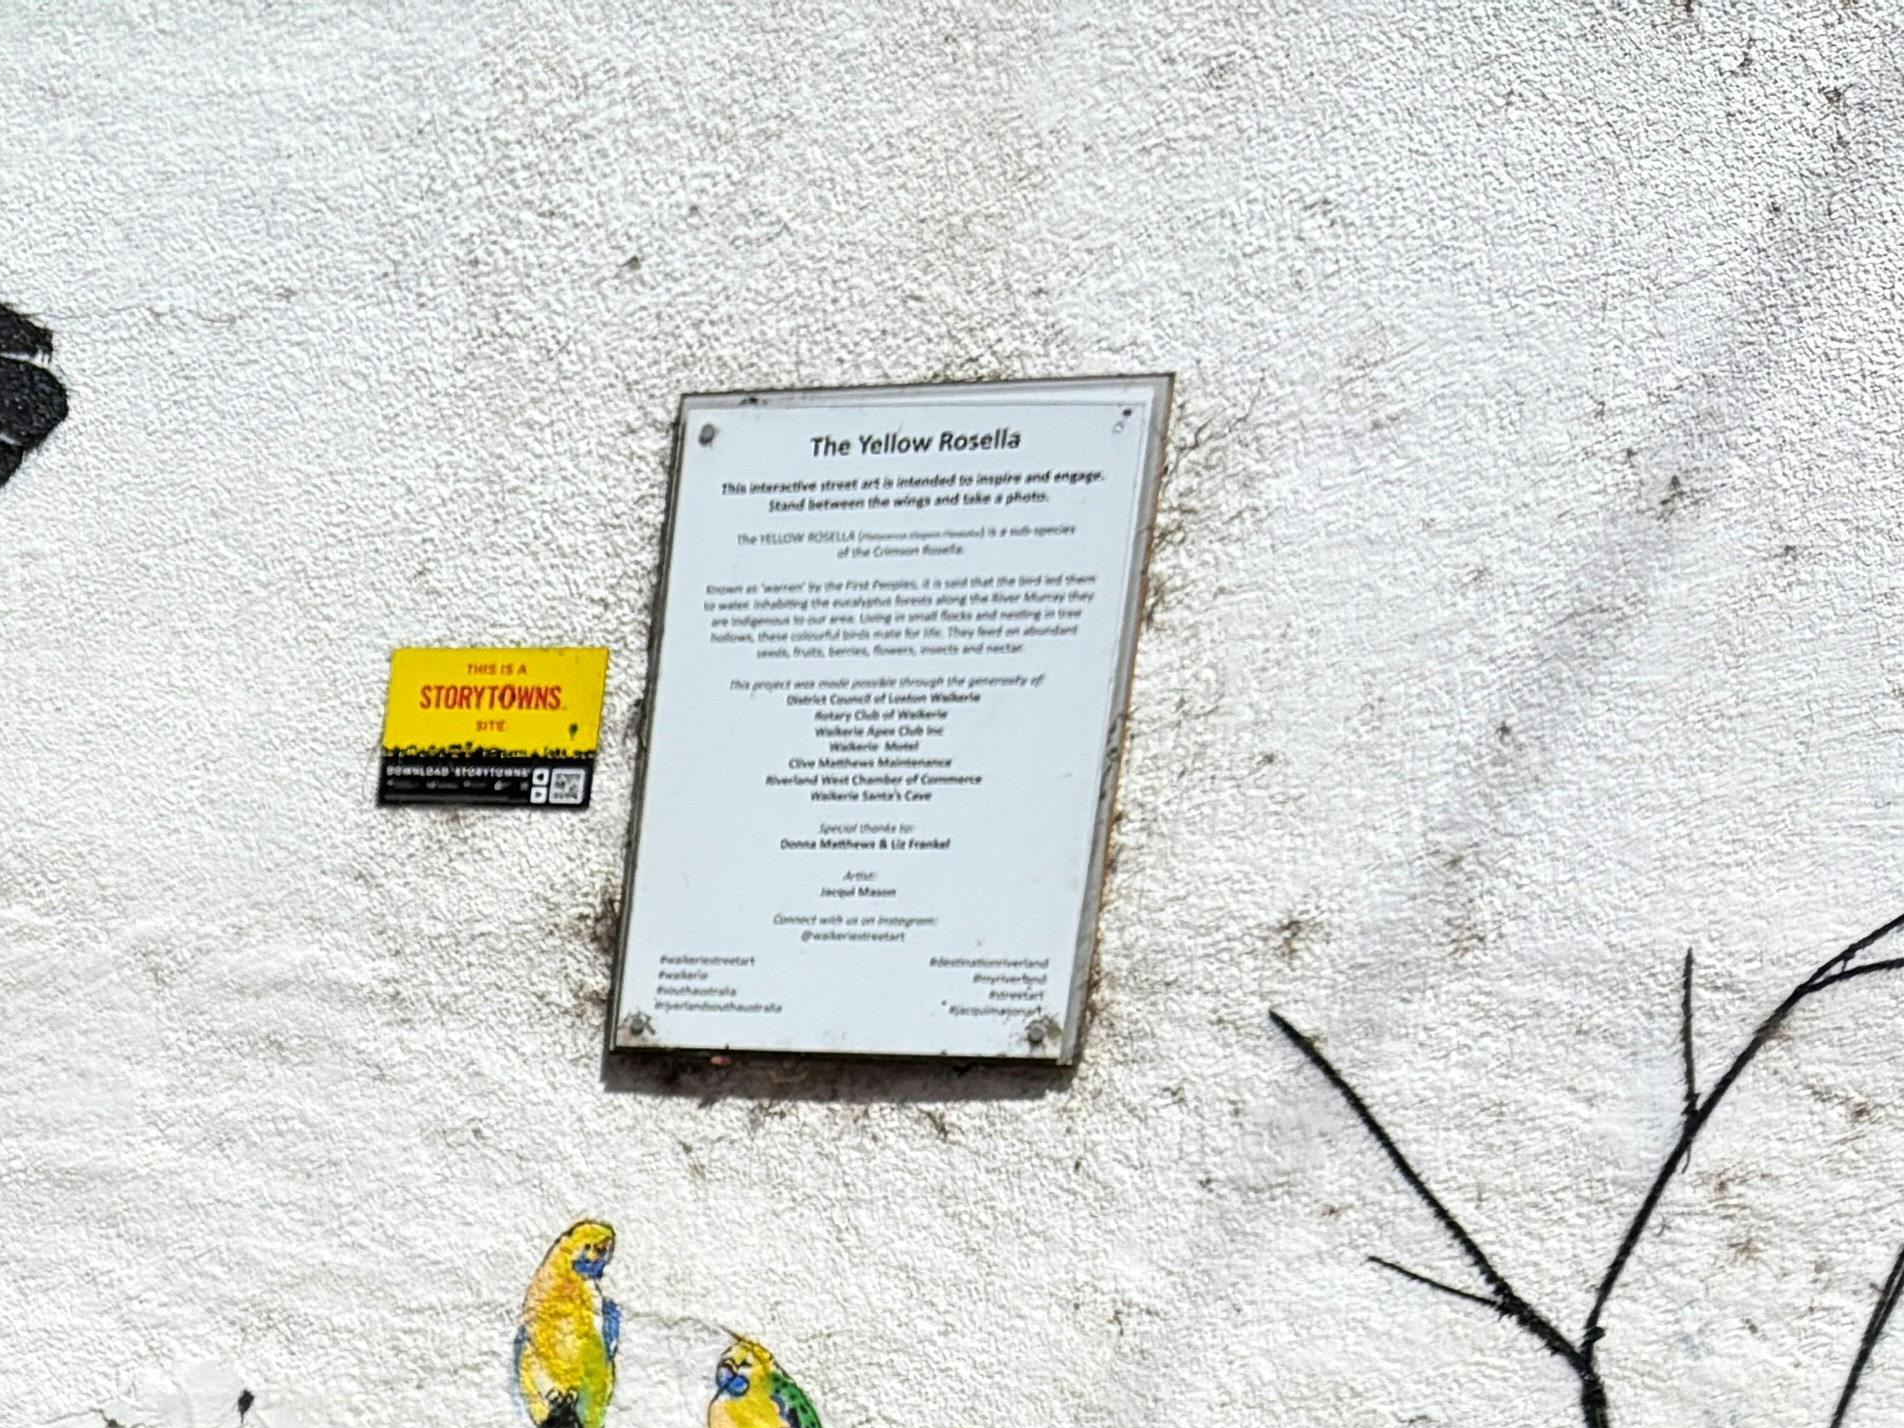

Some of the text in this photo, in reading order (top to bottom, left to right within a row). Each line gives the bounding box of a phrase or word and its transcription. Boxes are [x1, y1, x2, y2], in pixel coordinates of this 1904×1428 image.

[812, 428, 1021, 456] The Yellow Rosella
[721, 470, 1104, 494] This interactive street art is intended to inspire and engage.
[768, 490, 1049, 512] Stand between the wings and take a photo.
[467, 663, 528, 676] THIS IS A
[420, 684, 563, 711] STORYTOWNS
[476, 719, 507, 732] SITE
[387, 765, 450, 777] DOWNLOAD
